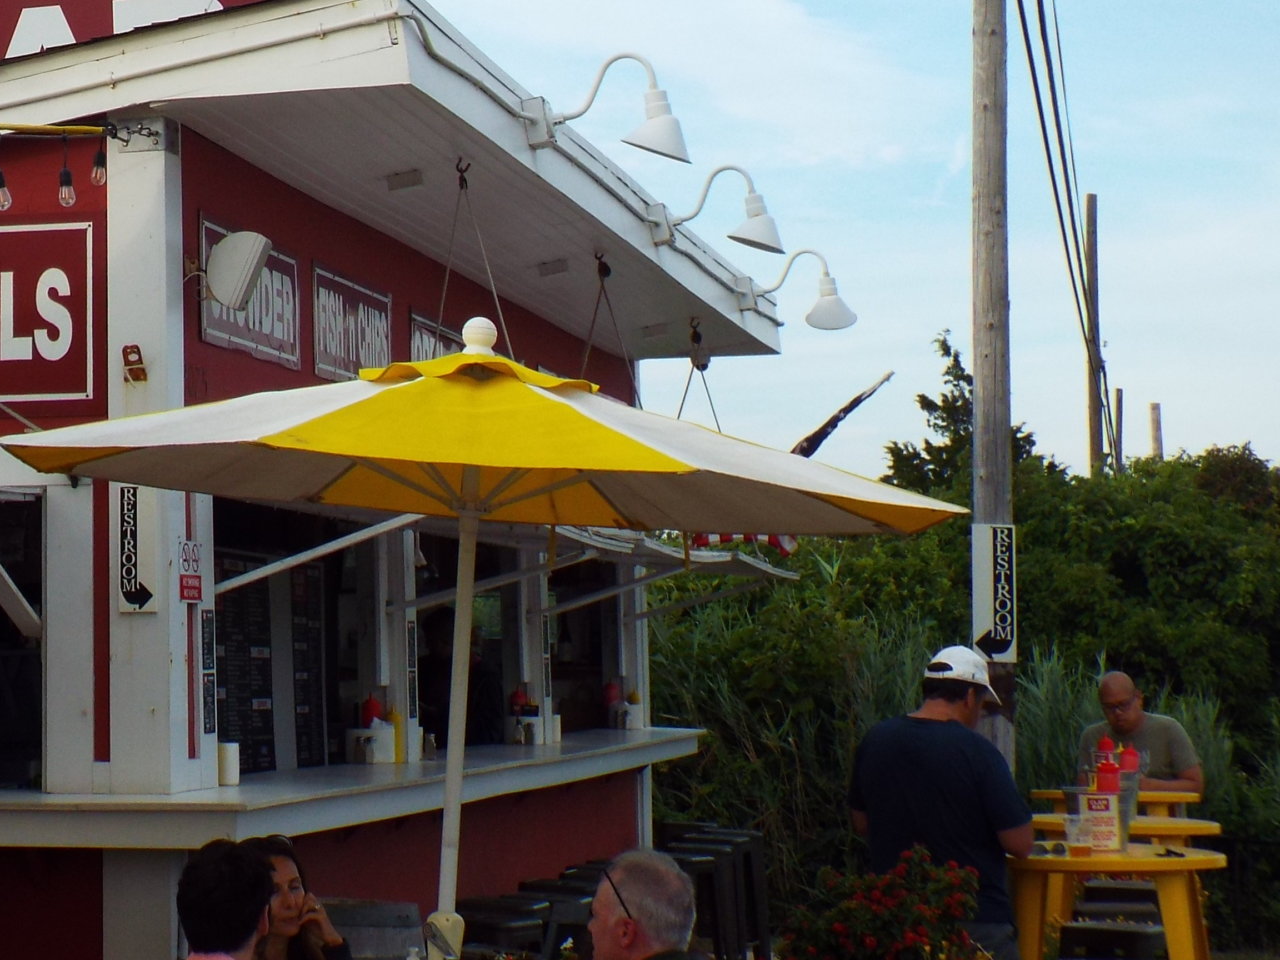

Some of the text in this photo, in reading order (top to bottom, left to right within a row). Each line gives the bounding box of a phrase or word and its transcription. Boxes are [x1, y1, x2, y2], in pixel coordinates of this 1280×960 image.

[318, 286, 344, 357] FISH
[358, 302, 388, 368] CHIPS
[122, 487, 136, 592] RESTROOM
[995, 528, 1012, 640] RESTROOM
